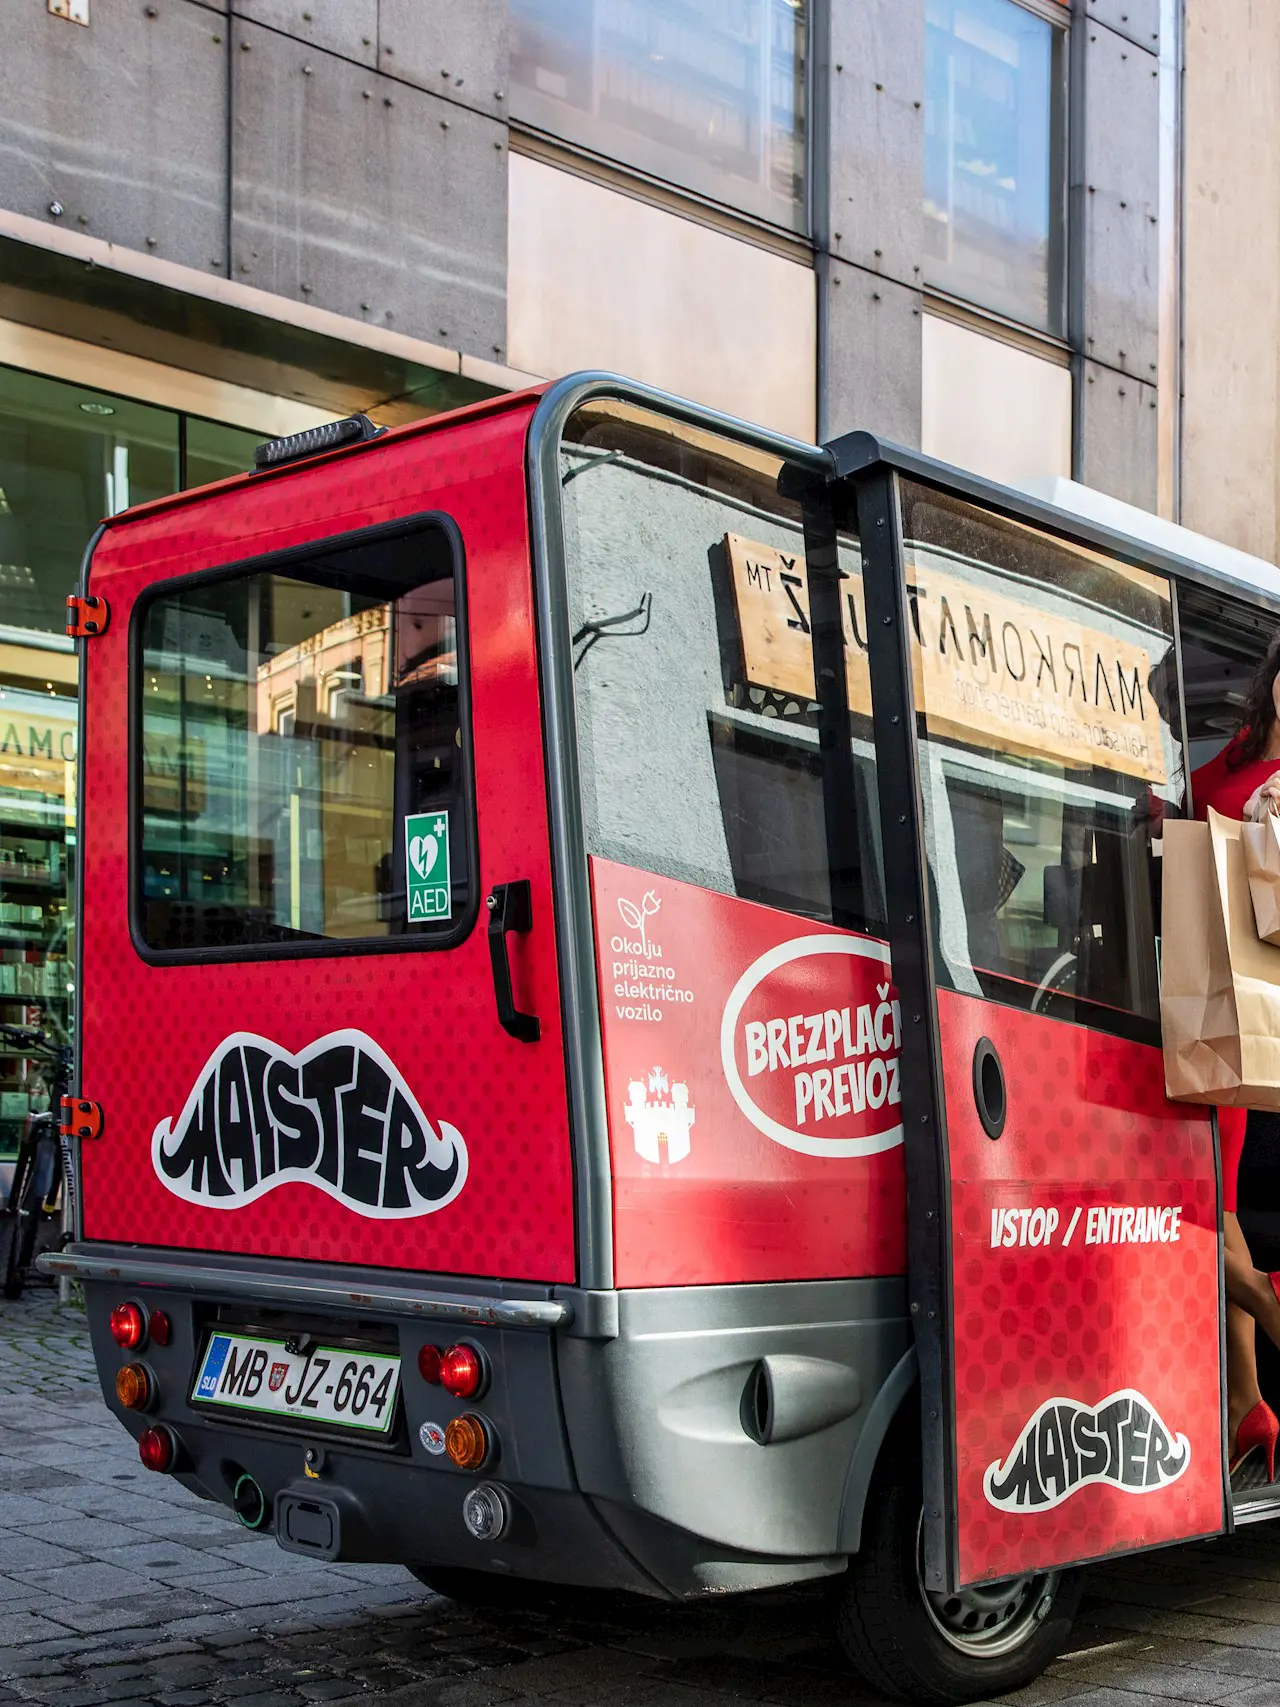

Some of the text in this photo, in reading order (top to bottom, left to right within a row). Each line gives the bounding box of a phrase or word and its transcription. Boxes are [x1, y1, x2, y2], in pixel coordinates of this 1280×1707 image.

[411, 888, 448, 915] AED
[610, 936, 662, 963] Okolju
[612, 961, 676, 981] prijazno
[614, 982, 694, 1003] električno
[616, 1004, 663, 1022] vozilo
[160, 1045, 458, 1208] MAISTER
[991, 1207, 1059, 1248] VSTOP
[1085, 1206, 1183, 1245] ENTRANCE
[201, 1347, 394, 1418] SLO MB JZ-664
[990, 1398, 1186, 1506] MAISTER
